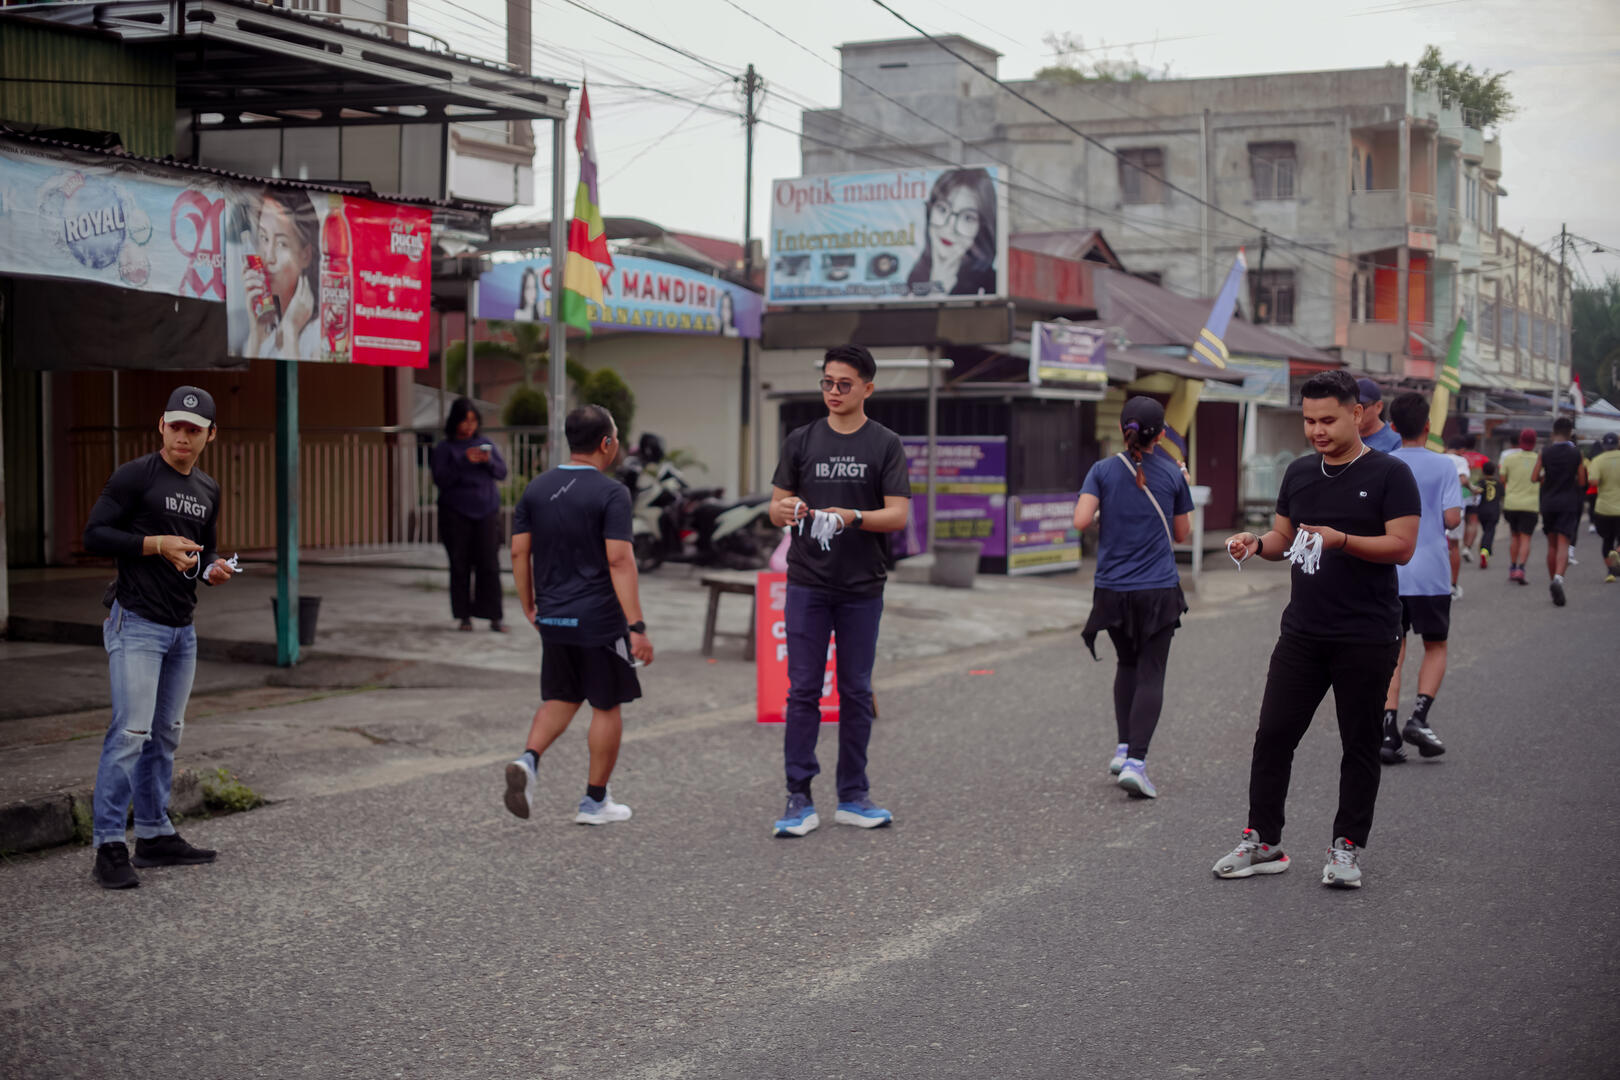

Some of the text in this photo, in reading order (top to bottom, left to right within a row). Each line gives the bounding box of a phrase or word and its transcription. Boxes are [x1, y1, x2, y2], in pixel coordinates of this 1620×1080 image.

[776, 172, 927, 214] Optik mandiri
[64, 205, 126, 243] ROYAL
[776, 222, 916, 252] International
[622, 269, 717, 309] MANDIRI
[545, 299, 717, 332] IERNATIONAL
[815, 463, 868, 478] IB/RGT
[165, 496, 207, 519] IB/RGT
